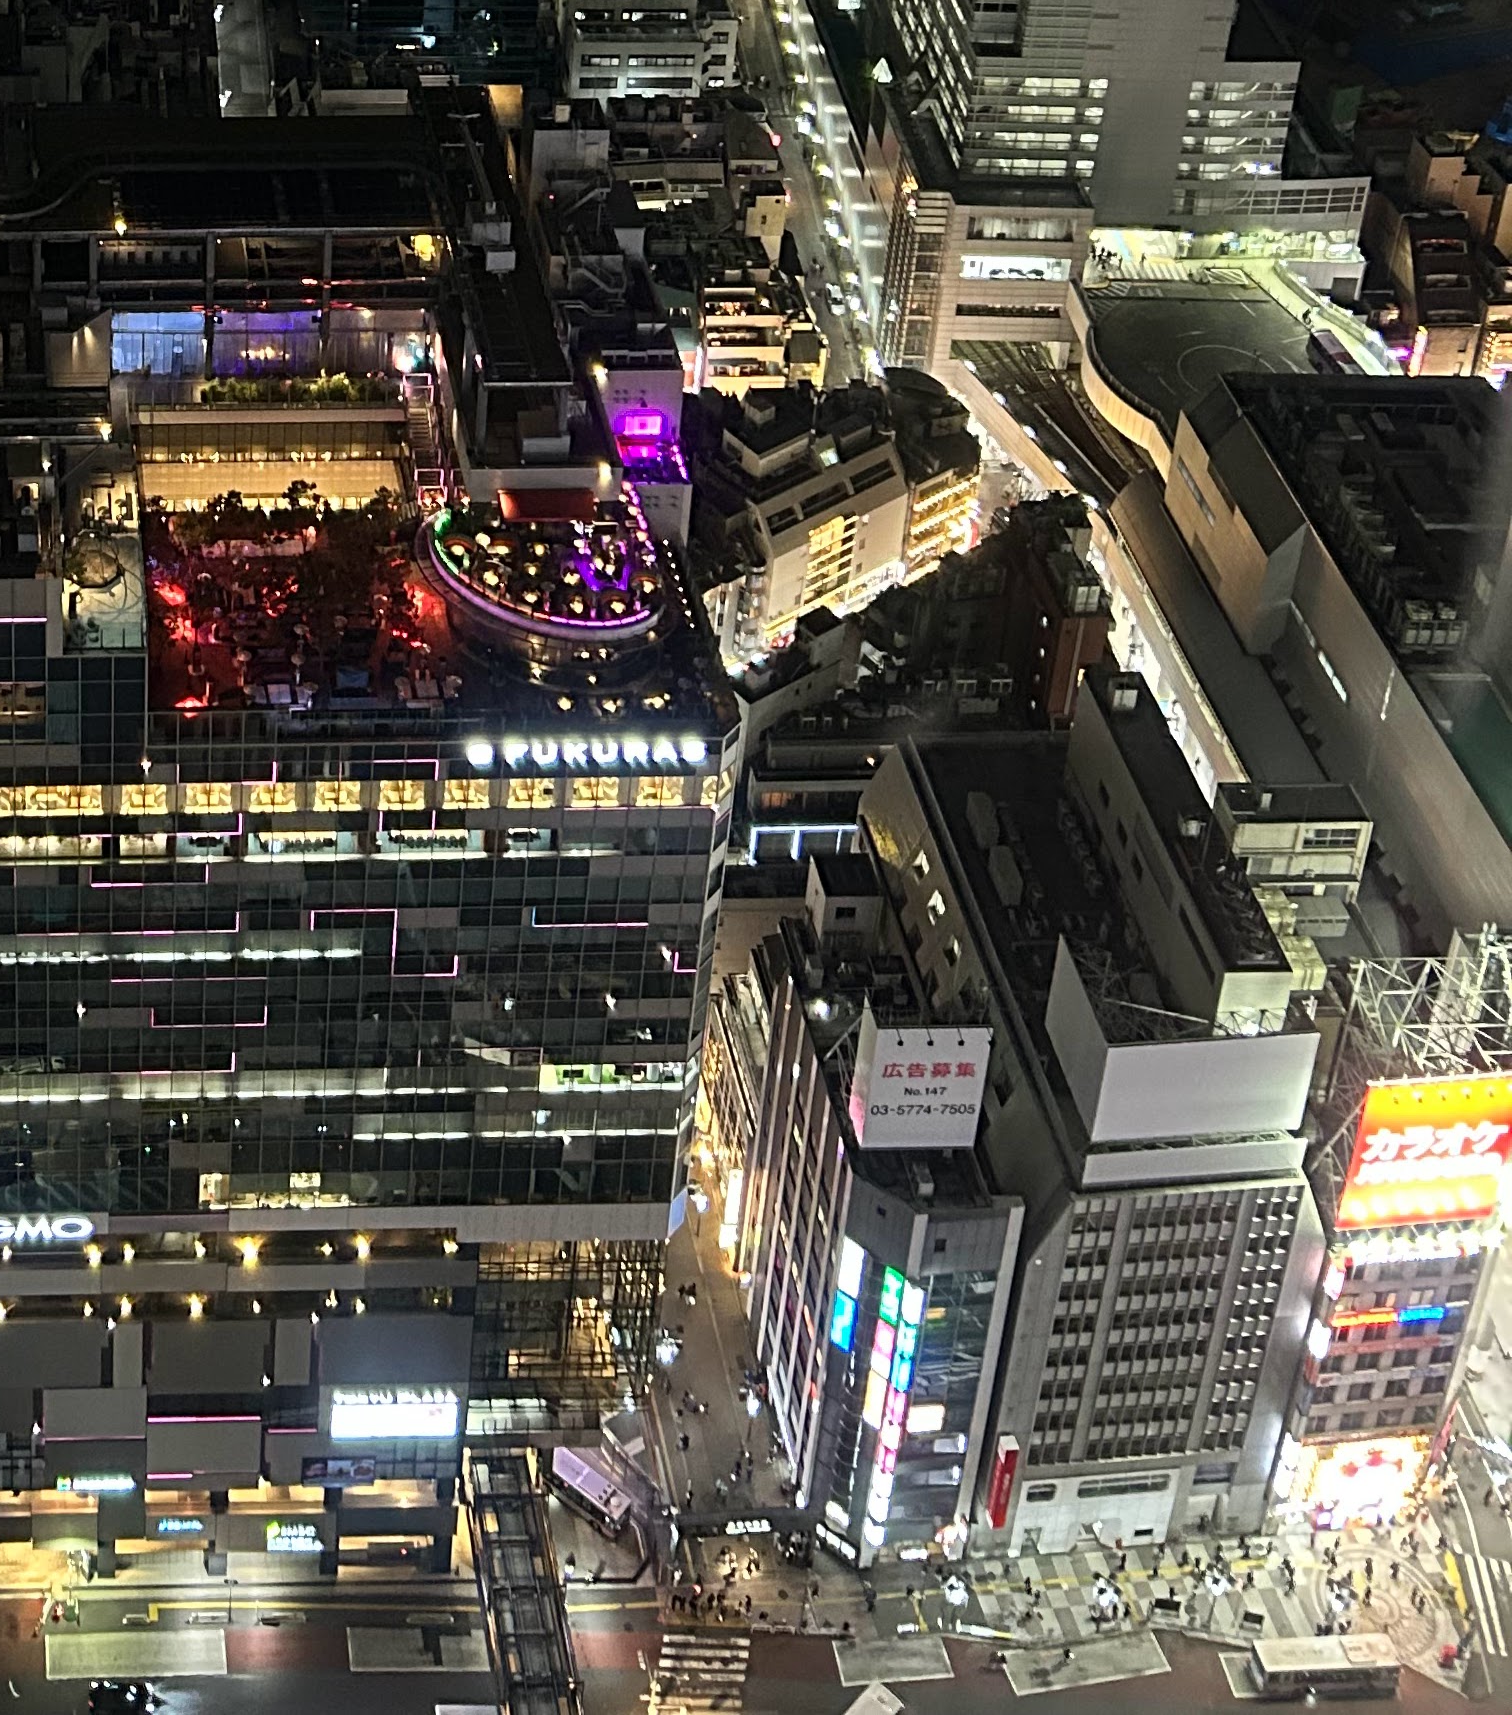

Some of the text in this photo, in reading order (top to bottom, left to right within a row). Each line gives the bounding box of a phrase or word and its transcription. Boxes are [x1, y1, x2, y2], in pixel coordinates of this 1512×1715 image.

[505, 740, 708, 764] FUKURAS
[882, 1062, 977, 1078] 広告募集
[870, 1104, 976, 1116] 03-5774-7505
[1361, 1122, 1508, 1161] カラオケ
